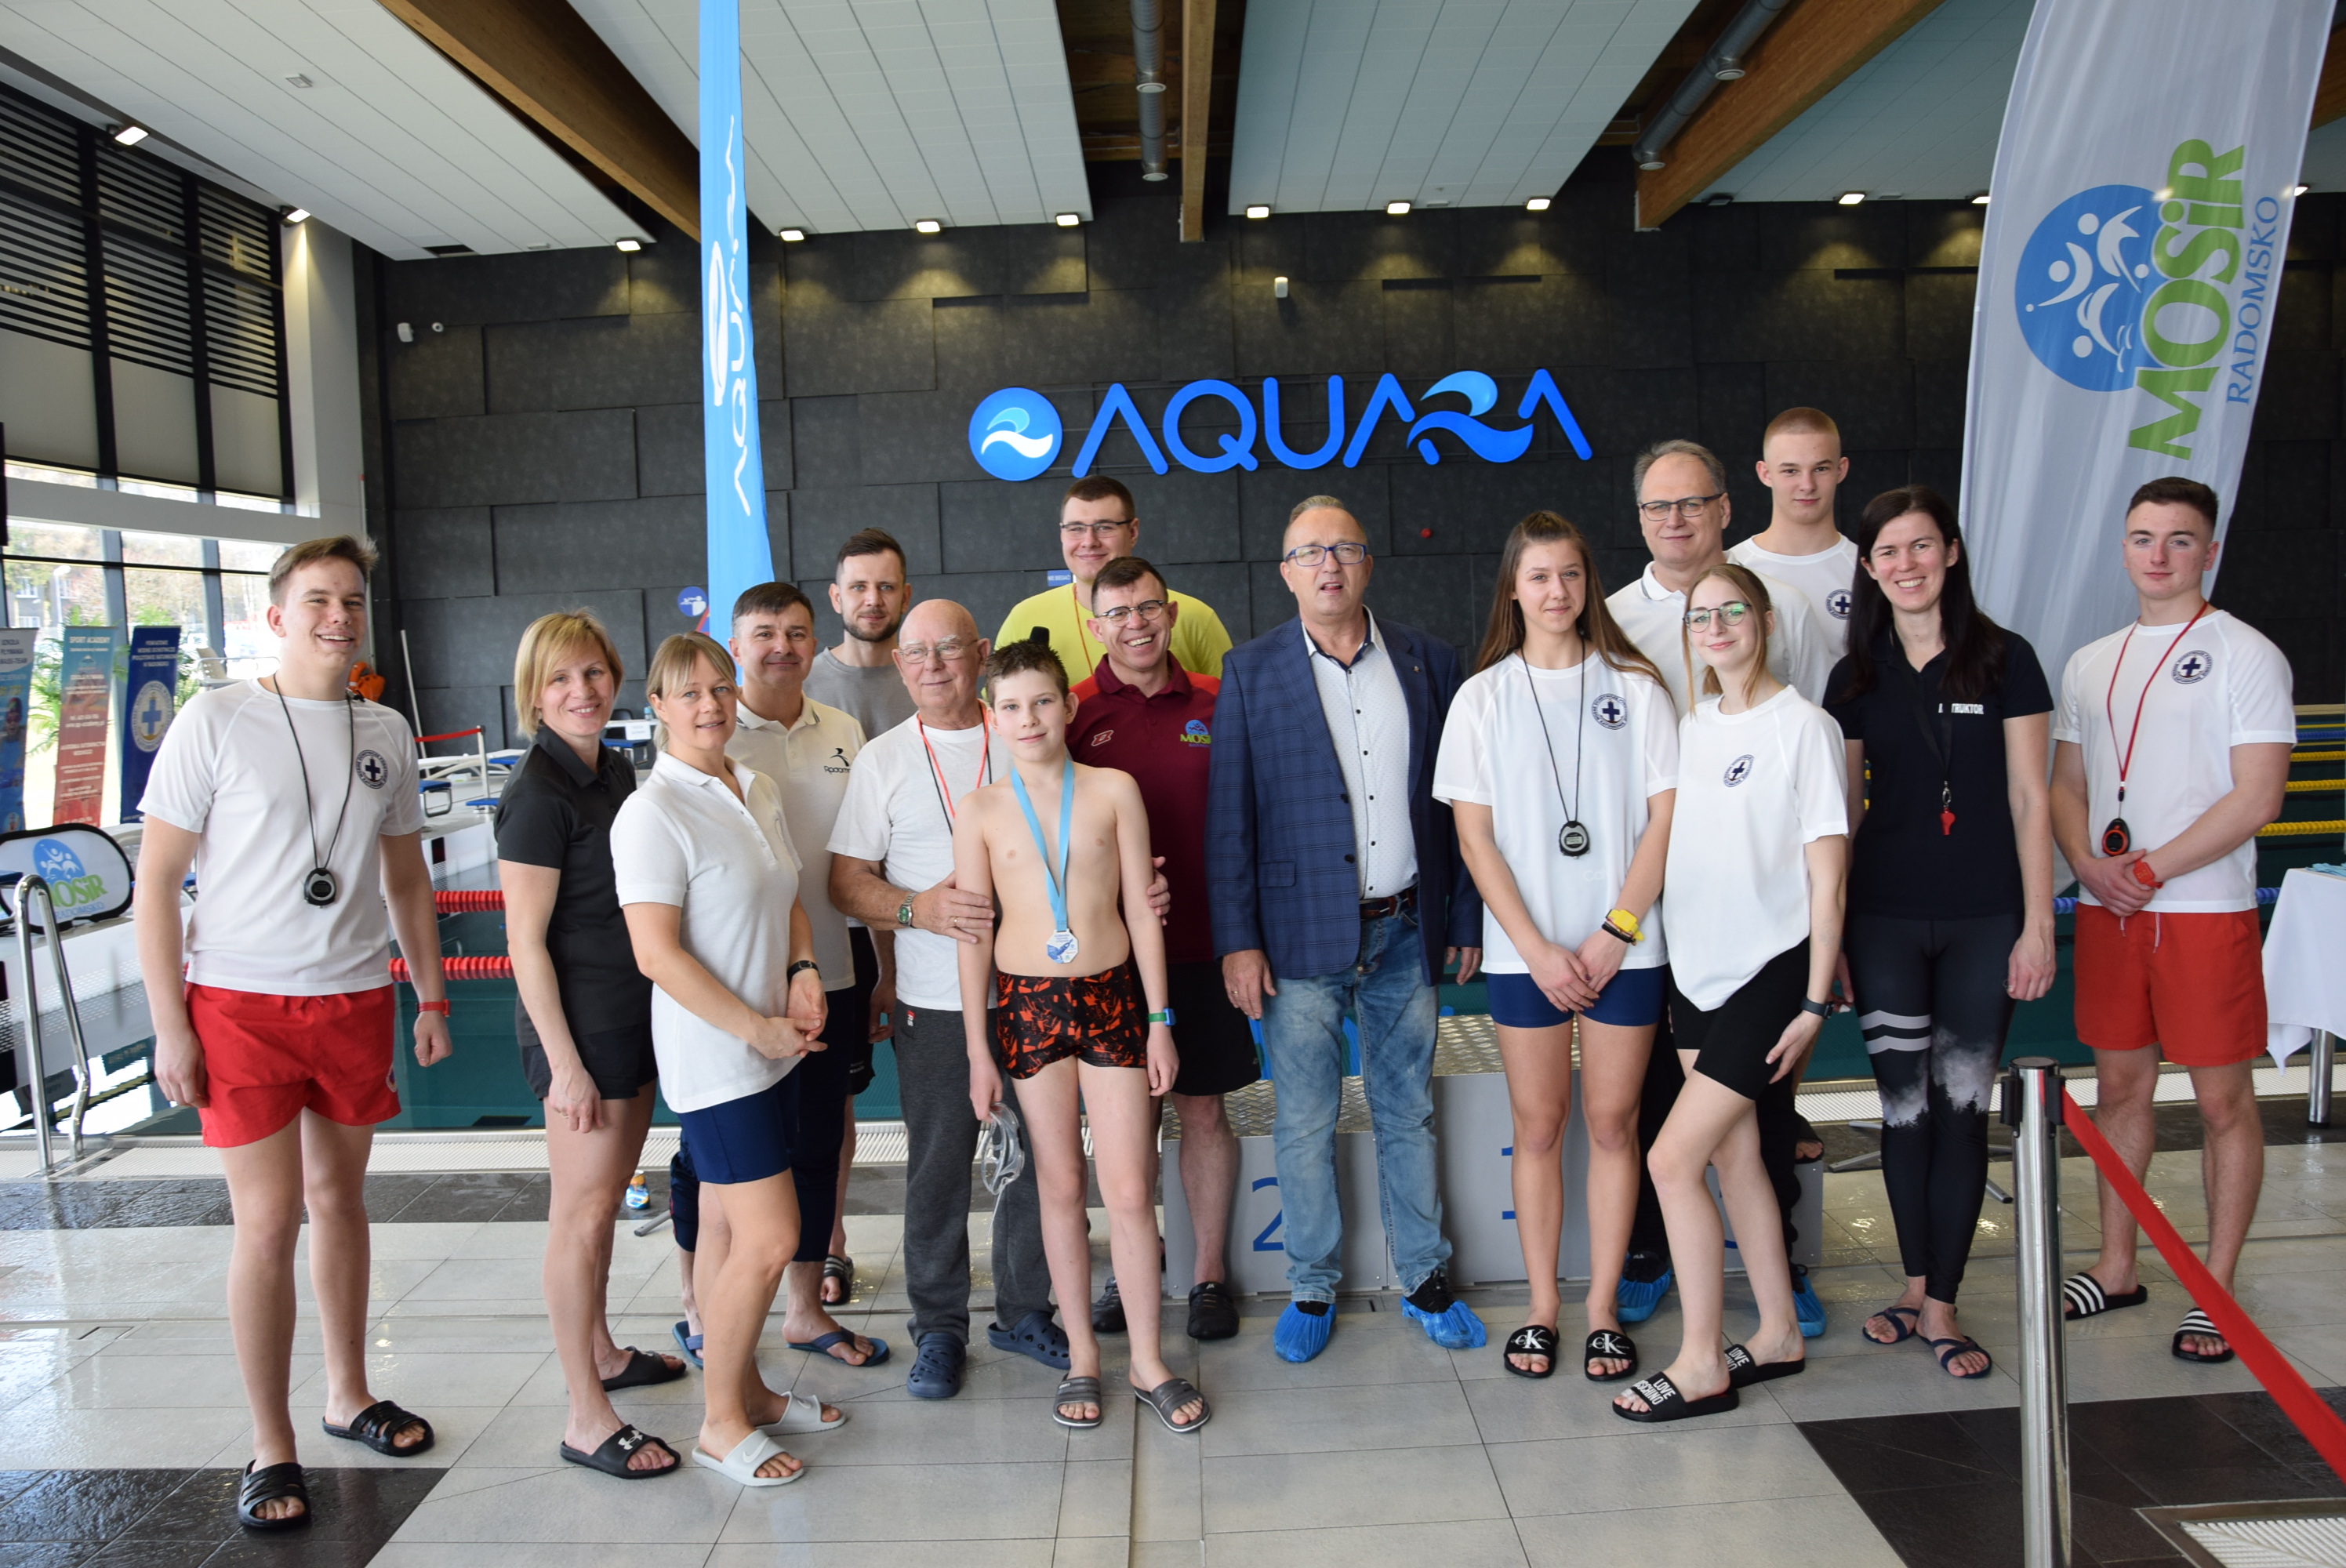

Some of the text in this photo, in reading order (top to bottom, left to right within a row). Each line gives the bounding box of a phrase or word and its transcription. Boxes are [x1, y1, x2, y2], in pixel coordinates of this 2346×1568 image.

[2226, 195, 2279, 406] RADOMSKO
[1938, 702, 1985, 715] ITRUKTOR
[1251, 1177, 1284, 1252] 2
[1728, 1347, 1750, 1367] LOVE
[1653, 1377, 1676, 1400] LOVE
